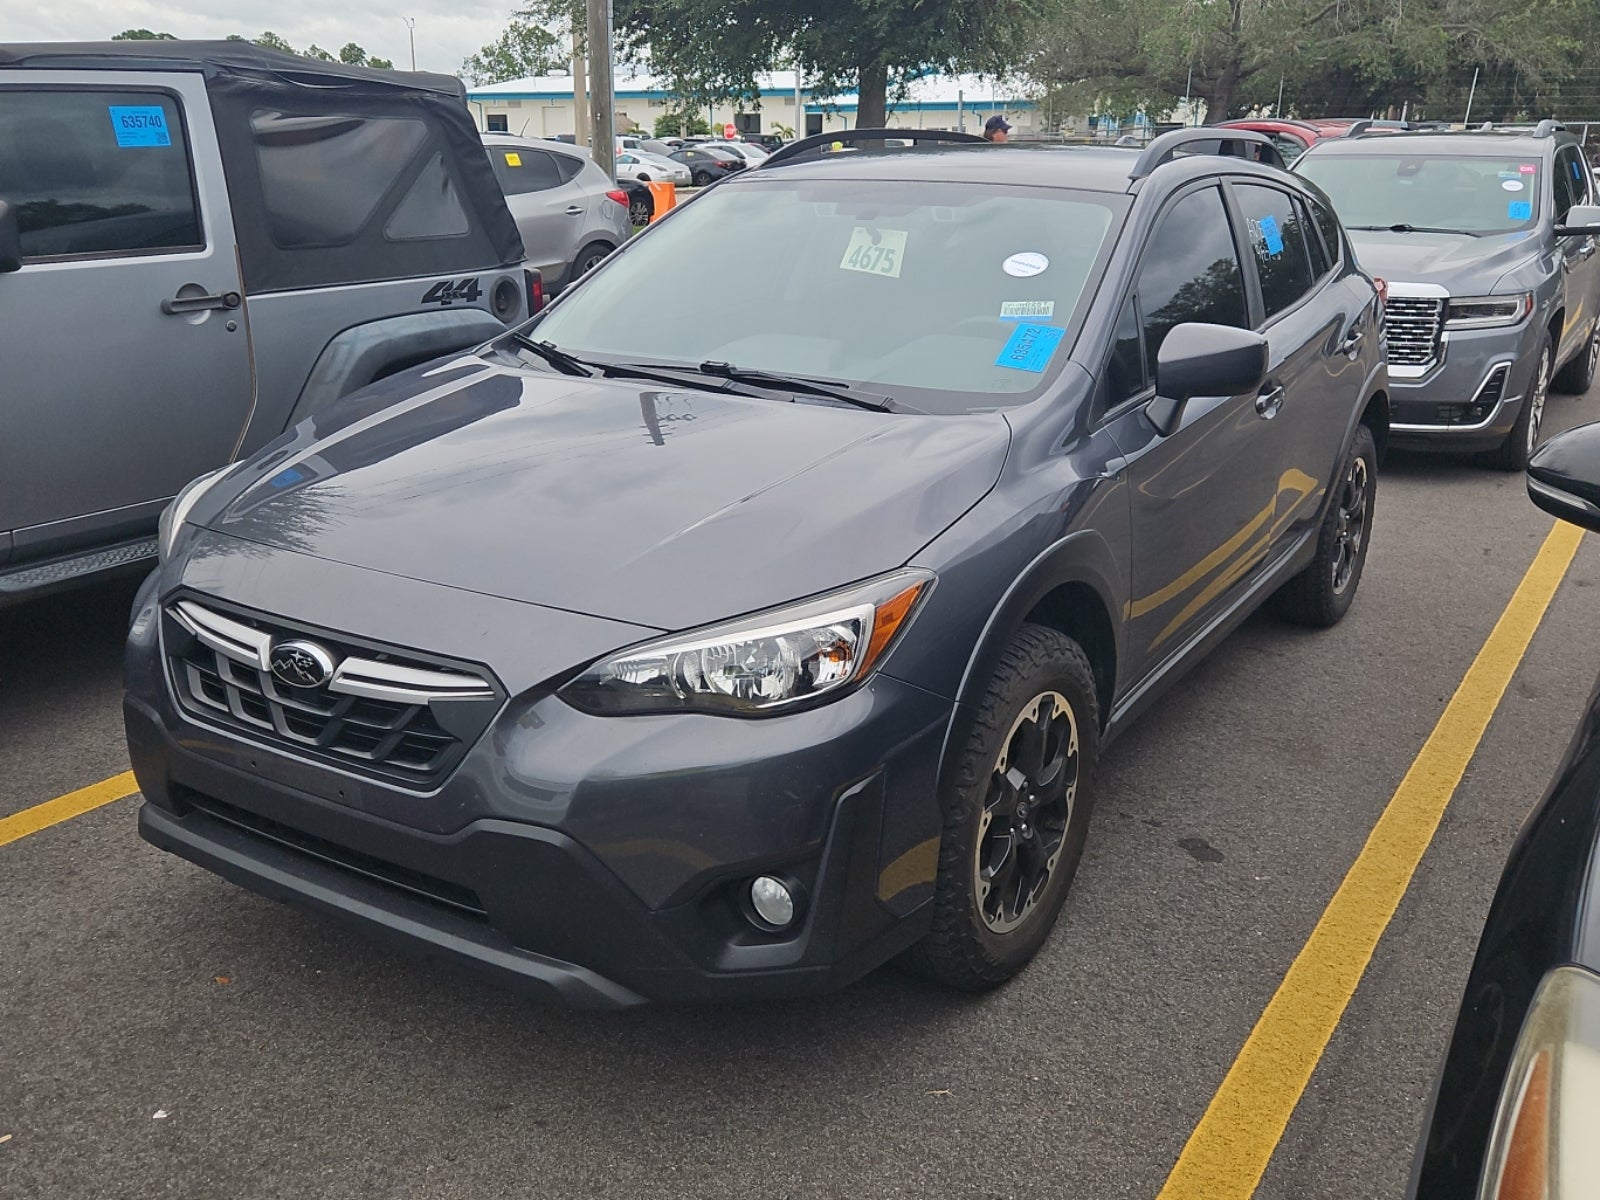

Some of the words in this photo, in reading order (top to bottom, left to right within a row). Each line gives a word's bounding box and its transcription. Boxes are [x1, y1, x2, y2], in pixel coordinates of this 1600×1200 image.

[121, 115, 162, 128] 635740
[848, 245, 896, 273] 4675
[1010, 328, 1042, 361] 635472
